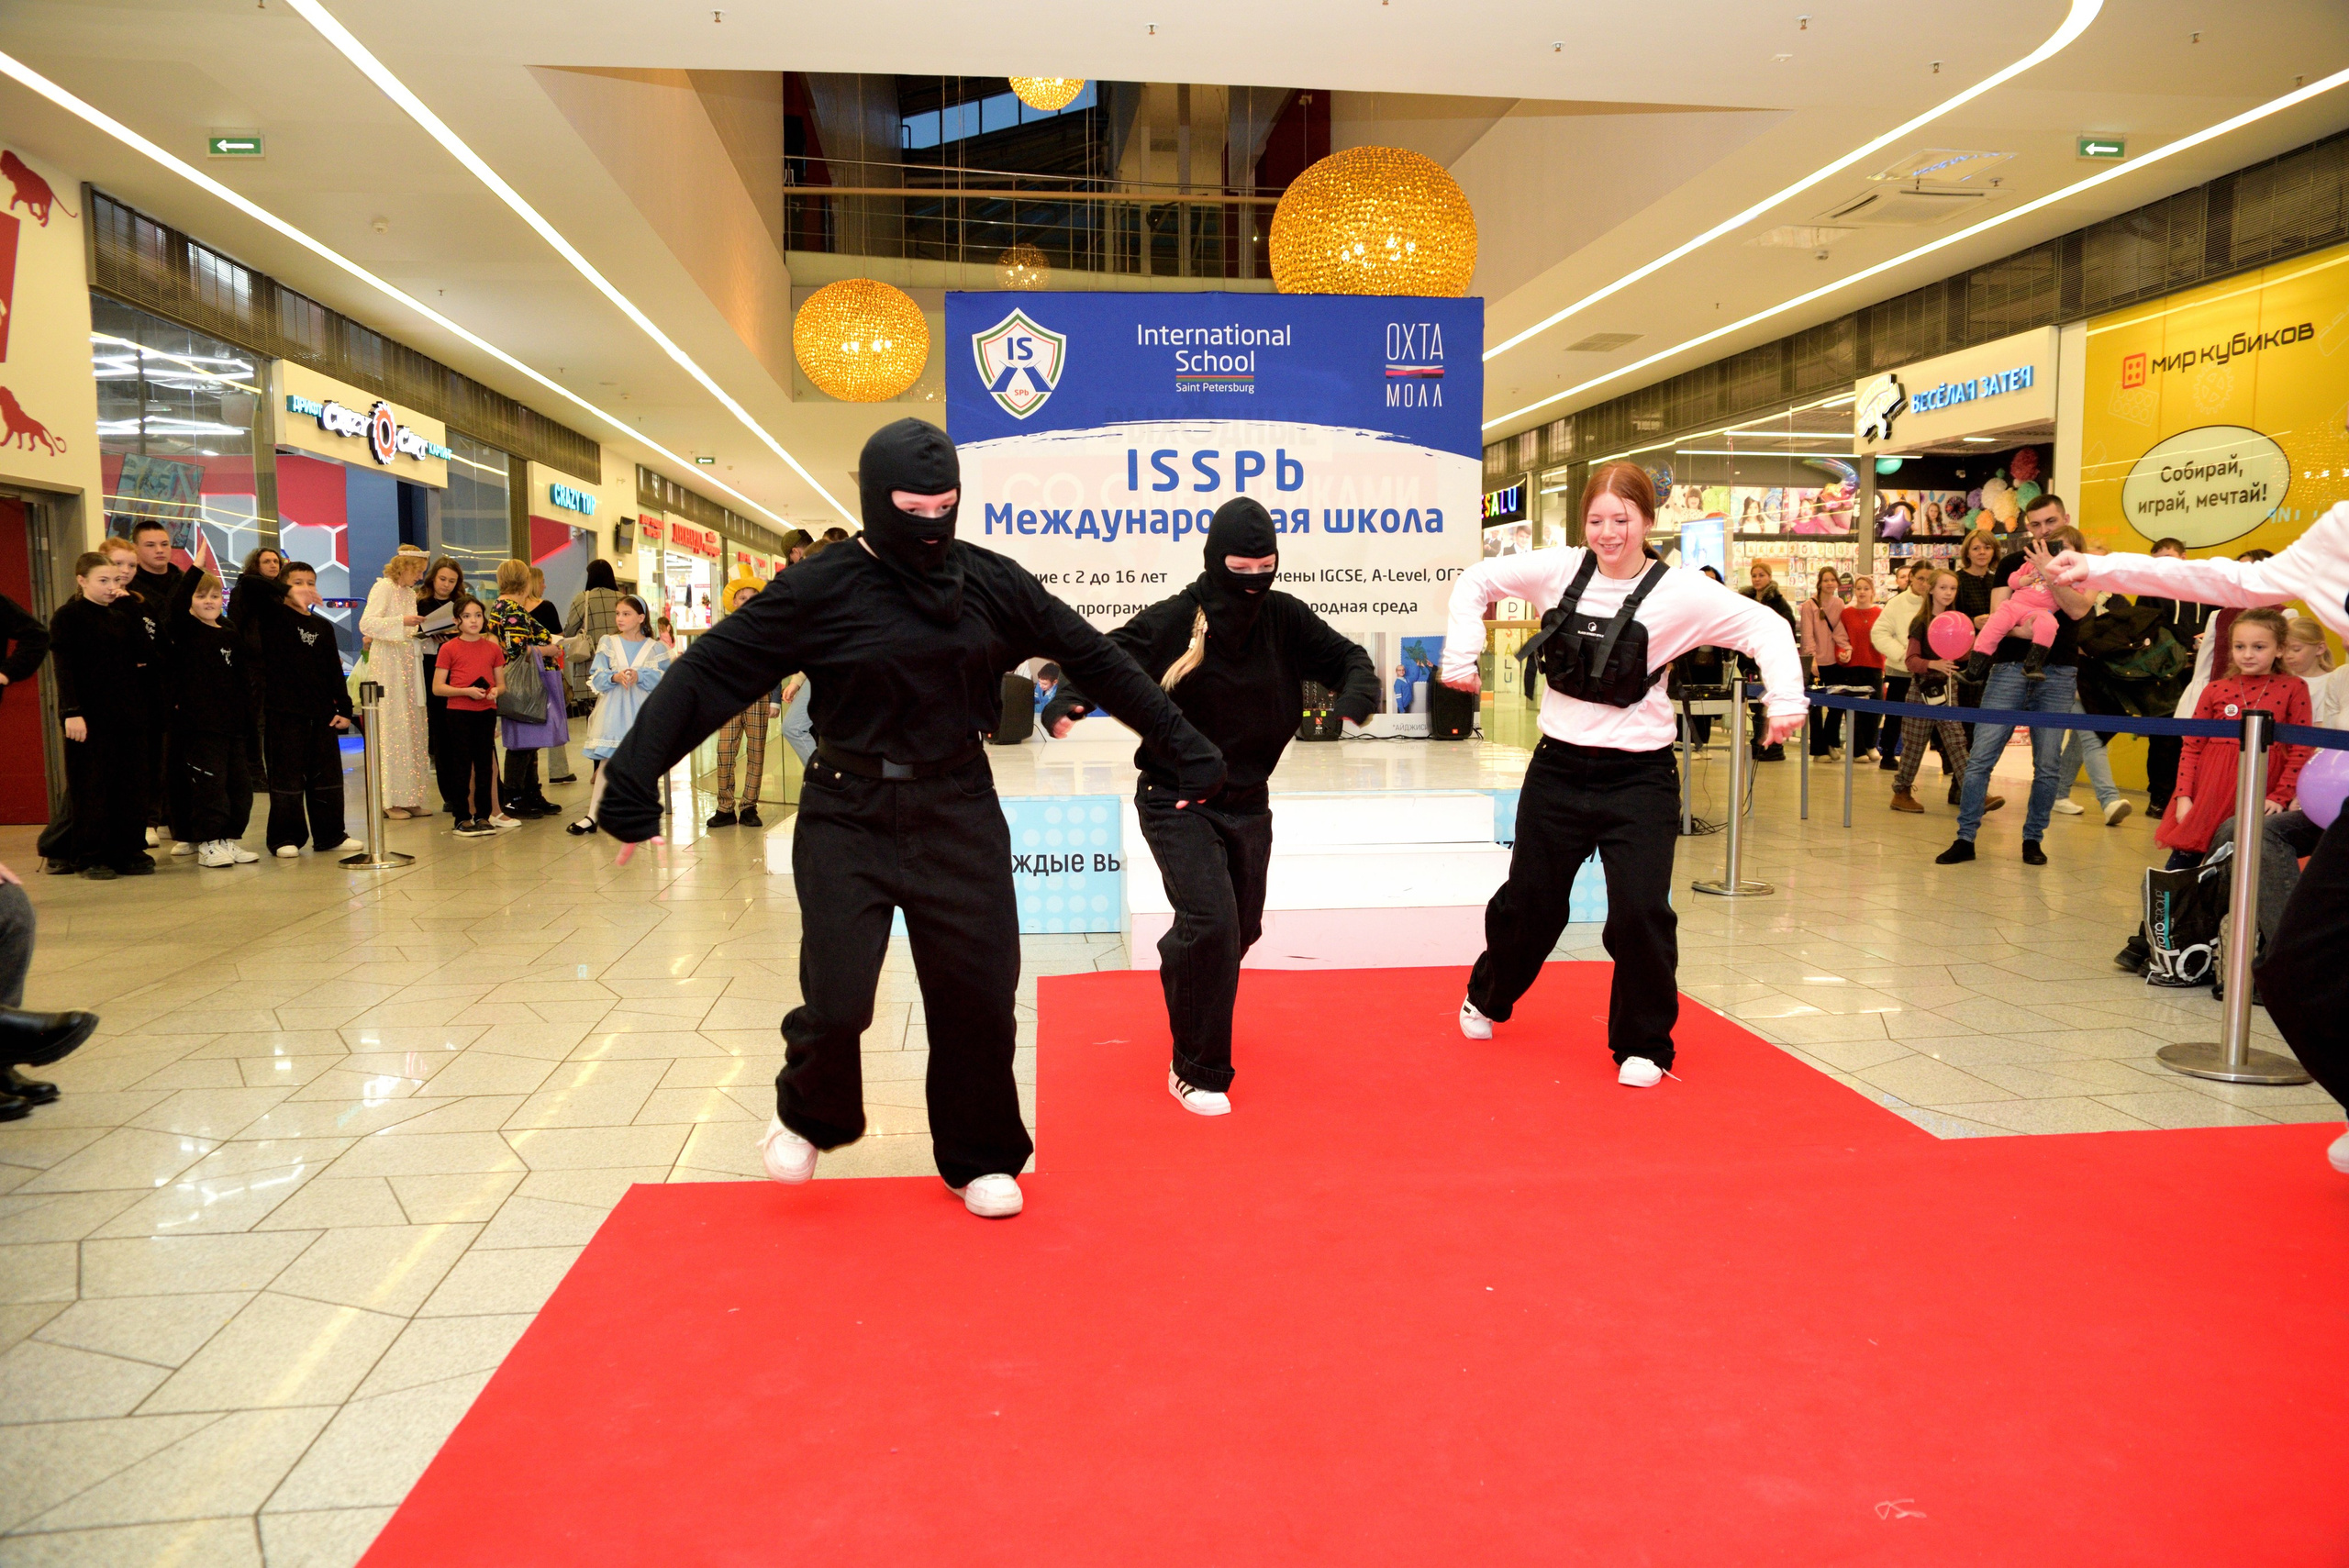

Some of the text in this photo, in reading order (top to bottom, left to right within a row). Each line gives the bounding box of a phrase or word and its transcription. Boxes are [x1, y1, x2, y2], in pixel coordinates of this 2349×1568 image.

[1138, 323, 1291, 346] International
[1386, 323, 1443, 361] ОХТА
[1007, 337, 1033, 361] IS
[1175, 350, 1255, 373] School
[1175, 383, 1255, 394] Saint Petersburg
[1386, 384, 1442, 407] МОЛЛ
[1910, 379, 1977, 414] ВЕСЁЛАЯ
[1980, 365, 2033, 398] ЗАТЕЯ
[1128, 449, 1305, 493] ISSPb
[2160, 453, 2243, 484] Собирай,
[552, 482, 580, 512] CRAZY
[2138, 482, 2267, 516] играй, мечтай!
[985, 502, 1444, 543] Междунароая школа
[1063, 573, 1071, 584] с
[1075, 570, 1085, 584] 2
[1089, 573, 1110, 586] до
[1116, 570, 1136, 584] 16
[1141, 573, 1168, 584] лет
[1274, 572, 1315, 583] мены
[1319, 569, 1367, 584] IGCSE,
[1371, 568, 1431, 584] A-Level,
[1076, 604, 1150, 617] програм
[1309, 602, 1419, 616] родная среда
[1012, 853, 1085, 877] ждые
